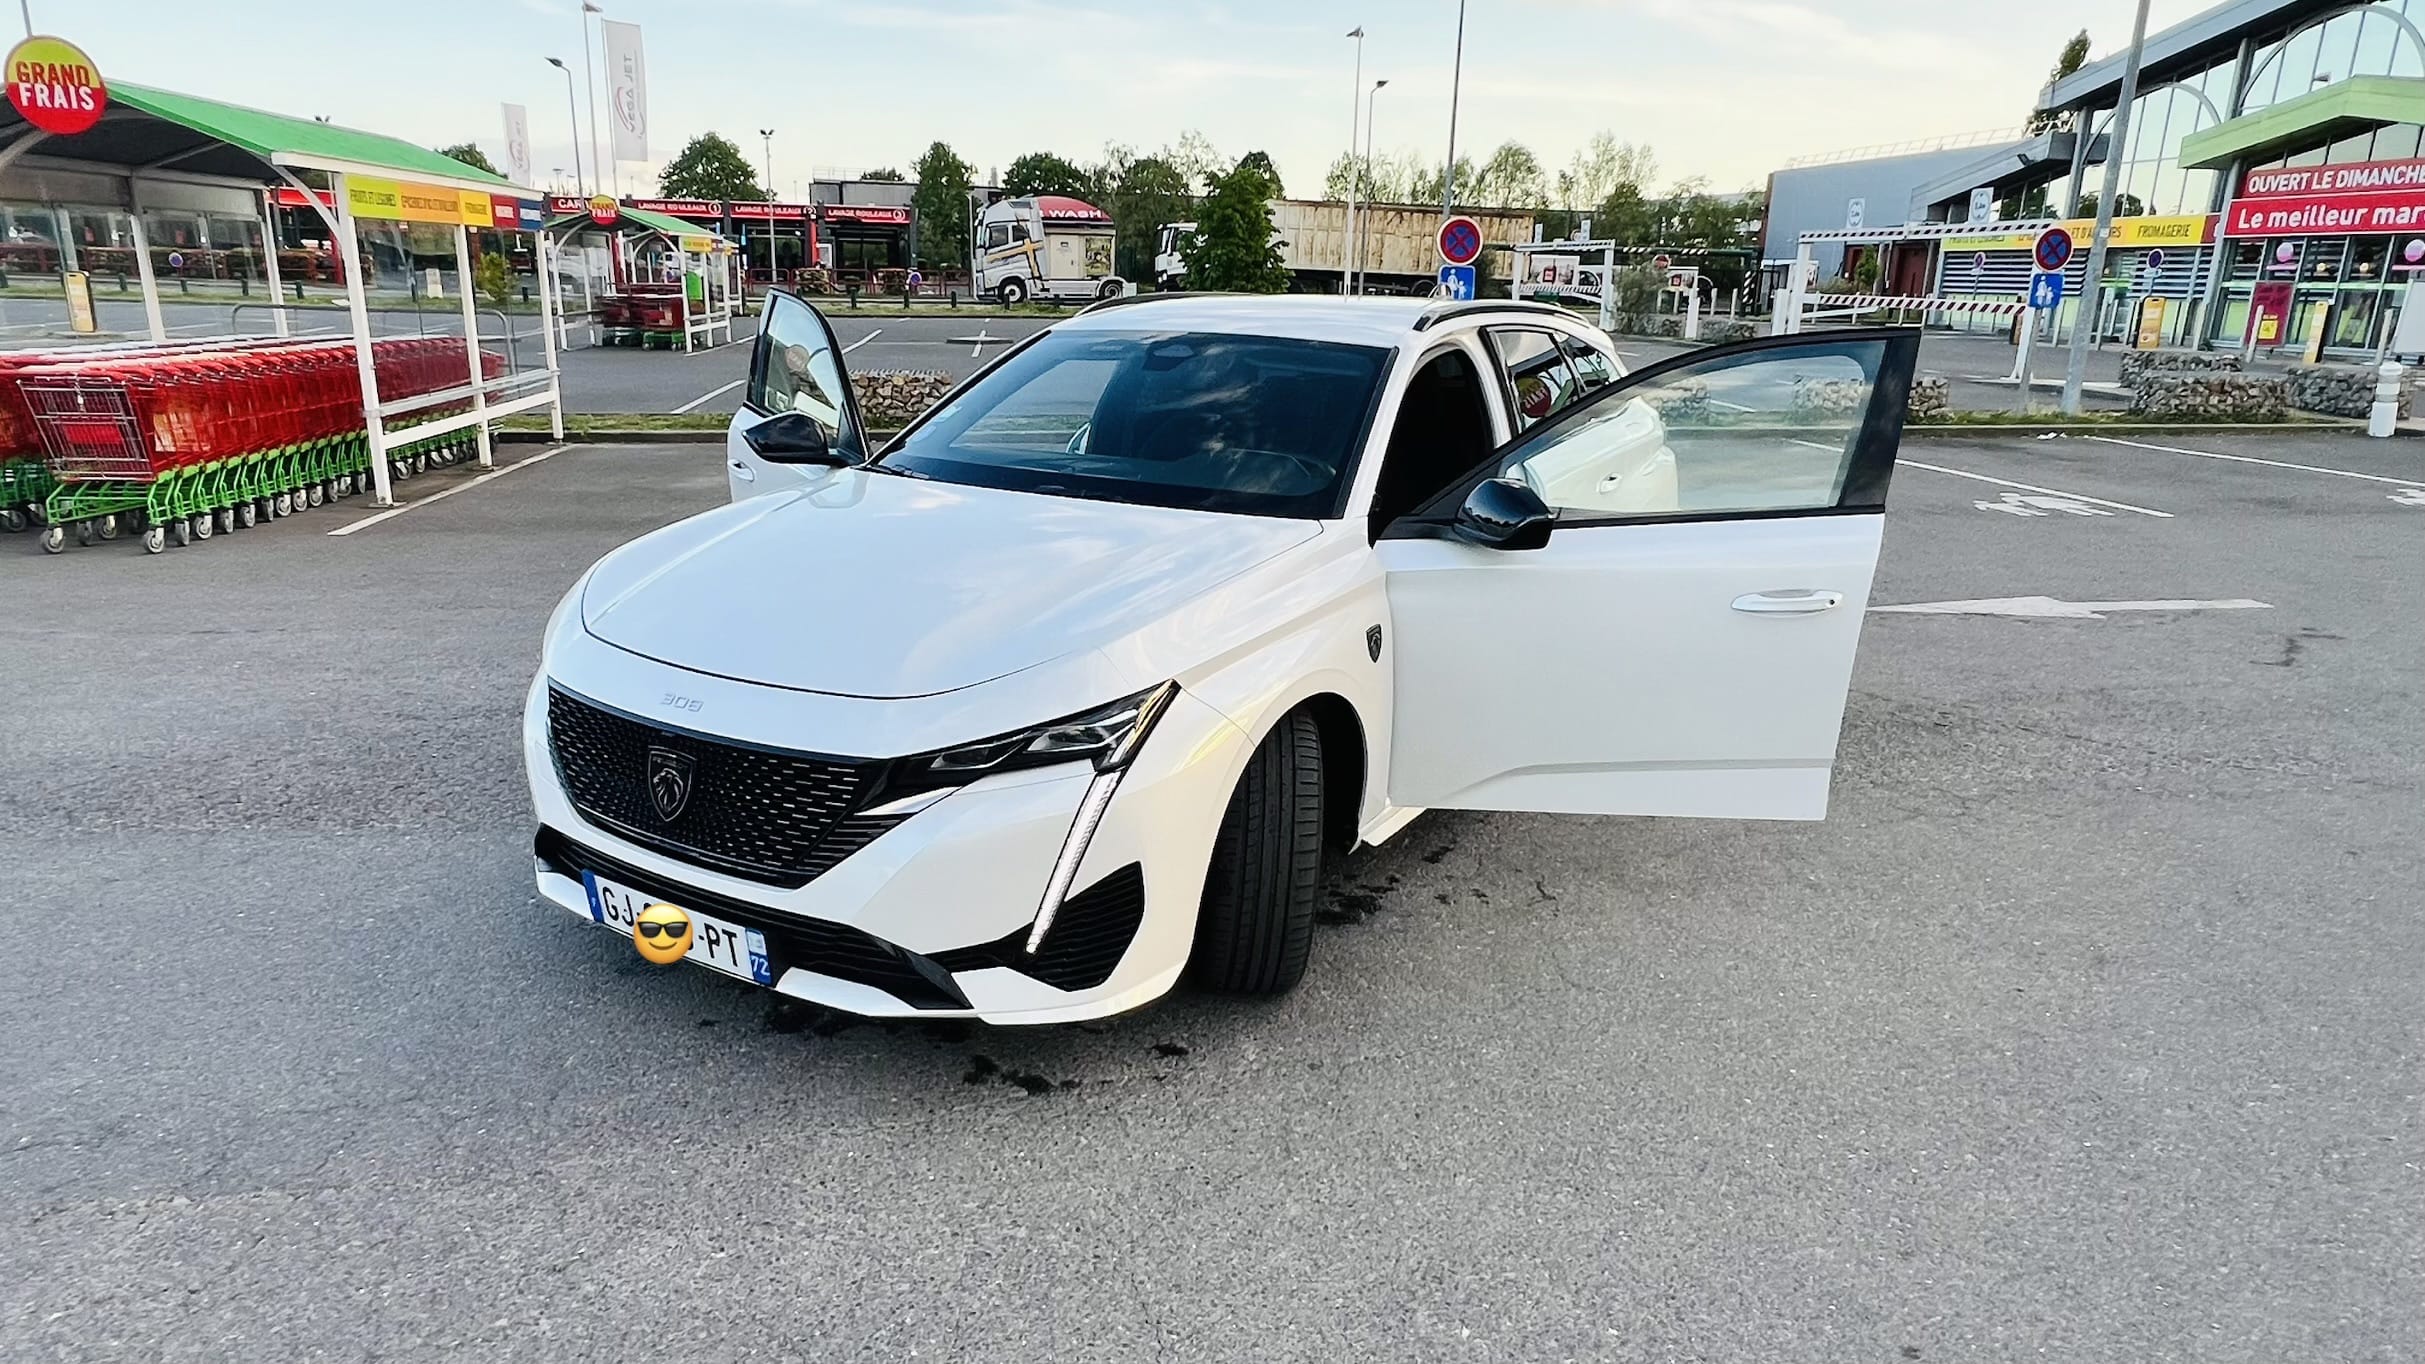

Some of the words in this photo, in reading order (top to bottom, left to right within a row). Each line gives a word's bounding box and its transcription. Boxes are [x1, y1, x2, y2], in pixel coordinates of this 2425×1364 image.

[16, 61, 90, 87] GRAND
[19, 83, 95, 111] FRAIS
[2249, 173, 2311, 193] OUVERT
[2311, 171, 2334, 190] LE
[2335, 165, 2425, 188] DIMANCHE
[1048, 209, 1101, 218] WASH
[2238, 208, 2264, 229] Le
[2267, 204, 2370, 228] meilleur
[2371, 205, 2425, 225] mar
[2137, 223, 2192, 238] FROMAGERIE
[660, 693, 704, 712] 308
[751, 955, 771, 976] 72
